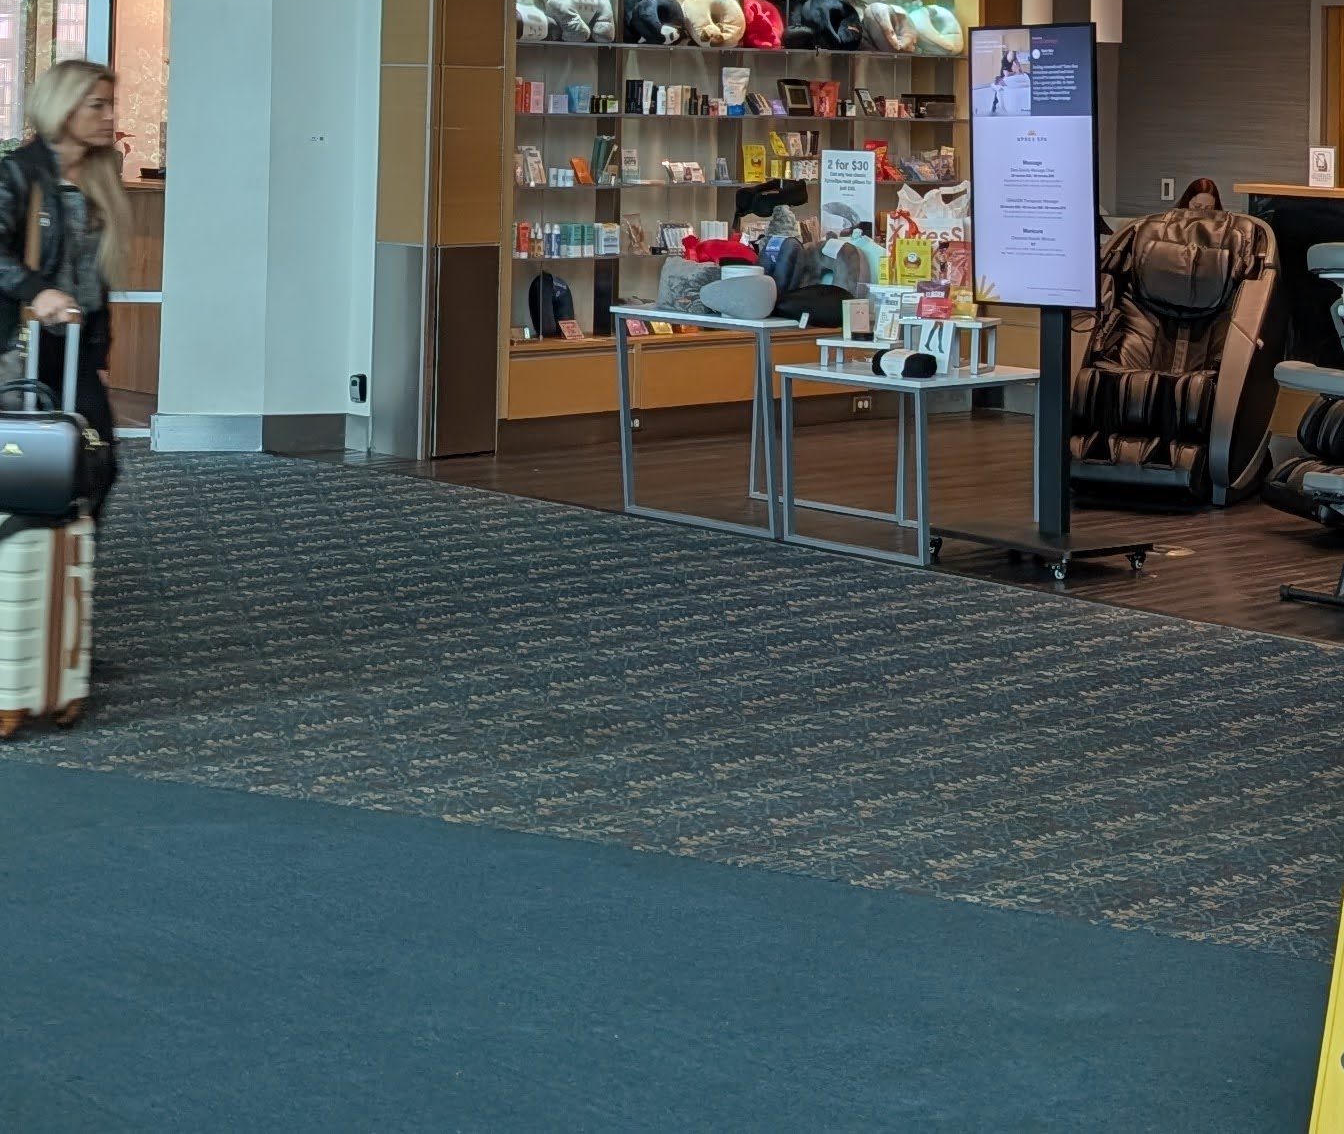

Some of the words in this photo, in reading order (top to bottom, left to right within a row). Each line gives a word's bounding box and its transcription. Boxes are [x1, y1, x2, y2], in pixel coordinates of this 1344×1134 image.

[827, 159, 833, 169] 2
[835, 159, 849, 170] for
[852, 160, 869, 171] $30
